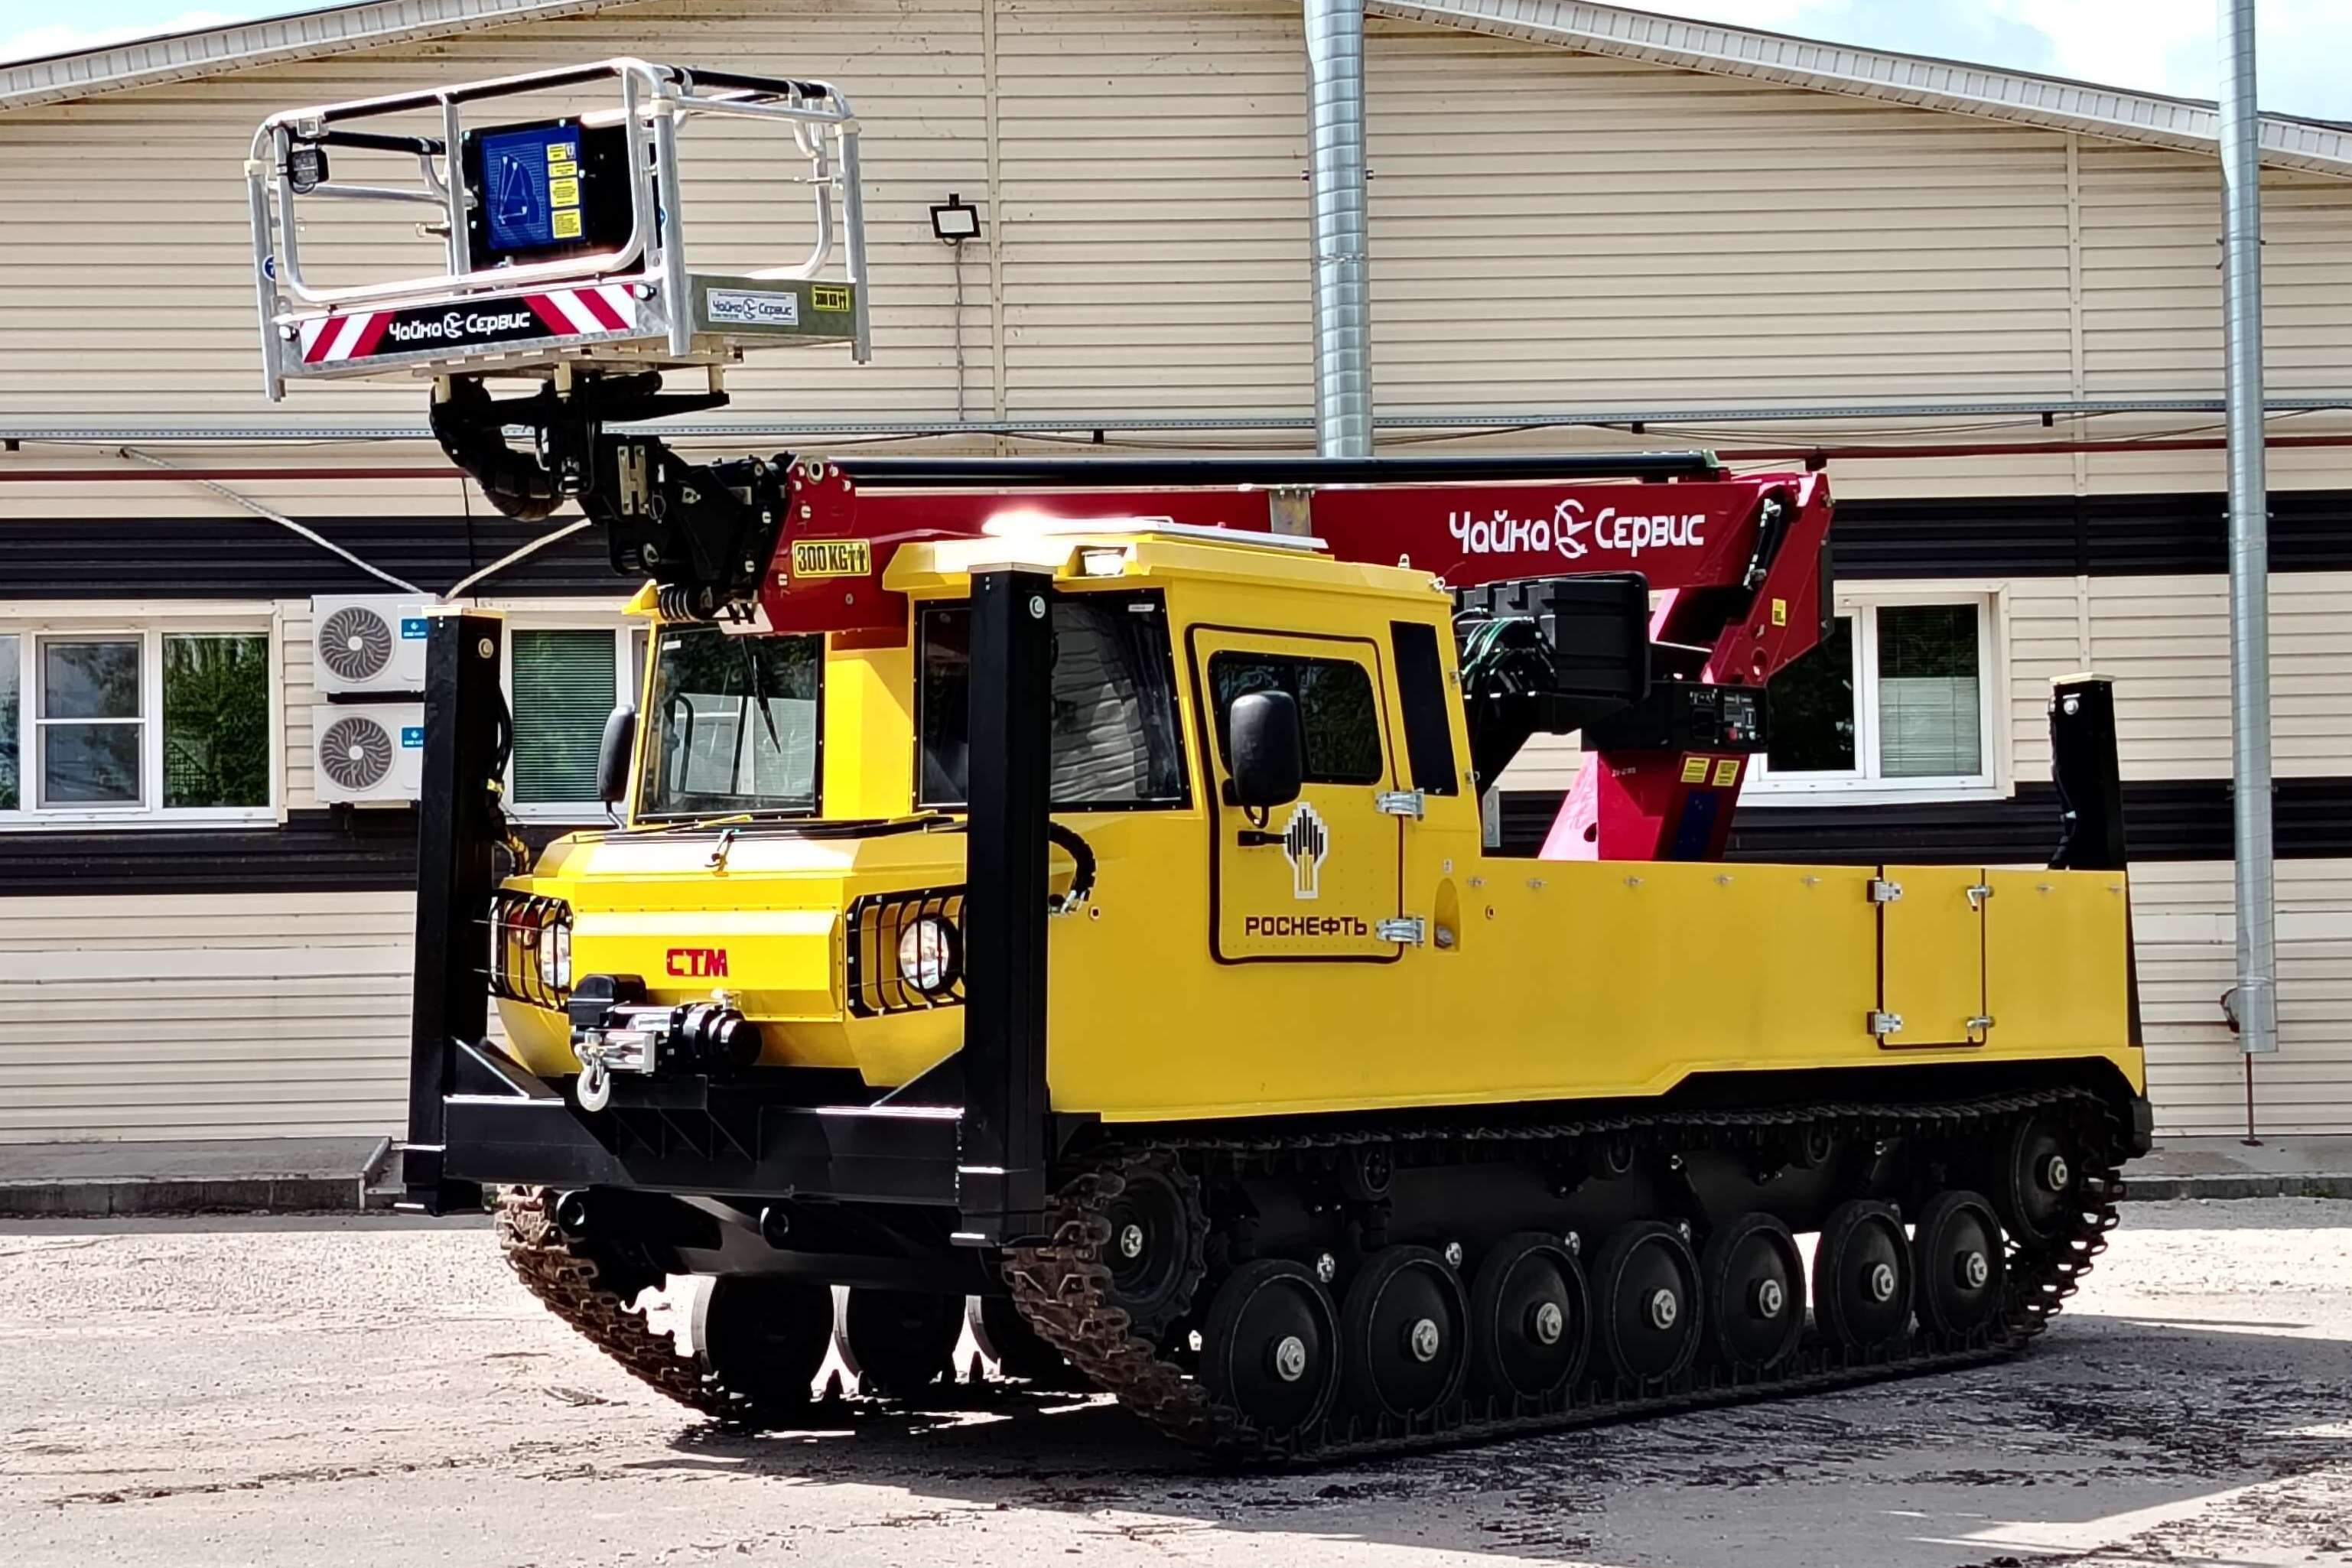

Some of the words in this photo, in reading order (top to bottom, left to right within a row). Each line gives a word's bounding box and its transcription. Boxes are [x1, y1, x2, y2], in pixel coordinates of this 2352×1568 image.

[389, 320, 442, 341] Чайка
[466, 311, 531, 335] Сервис
[1449, 509, 1550, 554] Чайка
[1594, 507, 1706, 558] Сервис
[1245, 916, 1368, 936] РОСНЕФТЬ
[666, 948, 728, 977] СТМ
